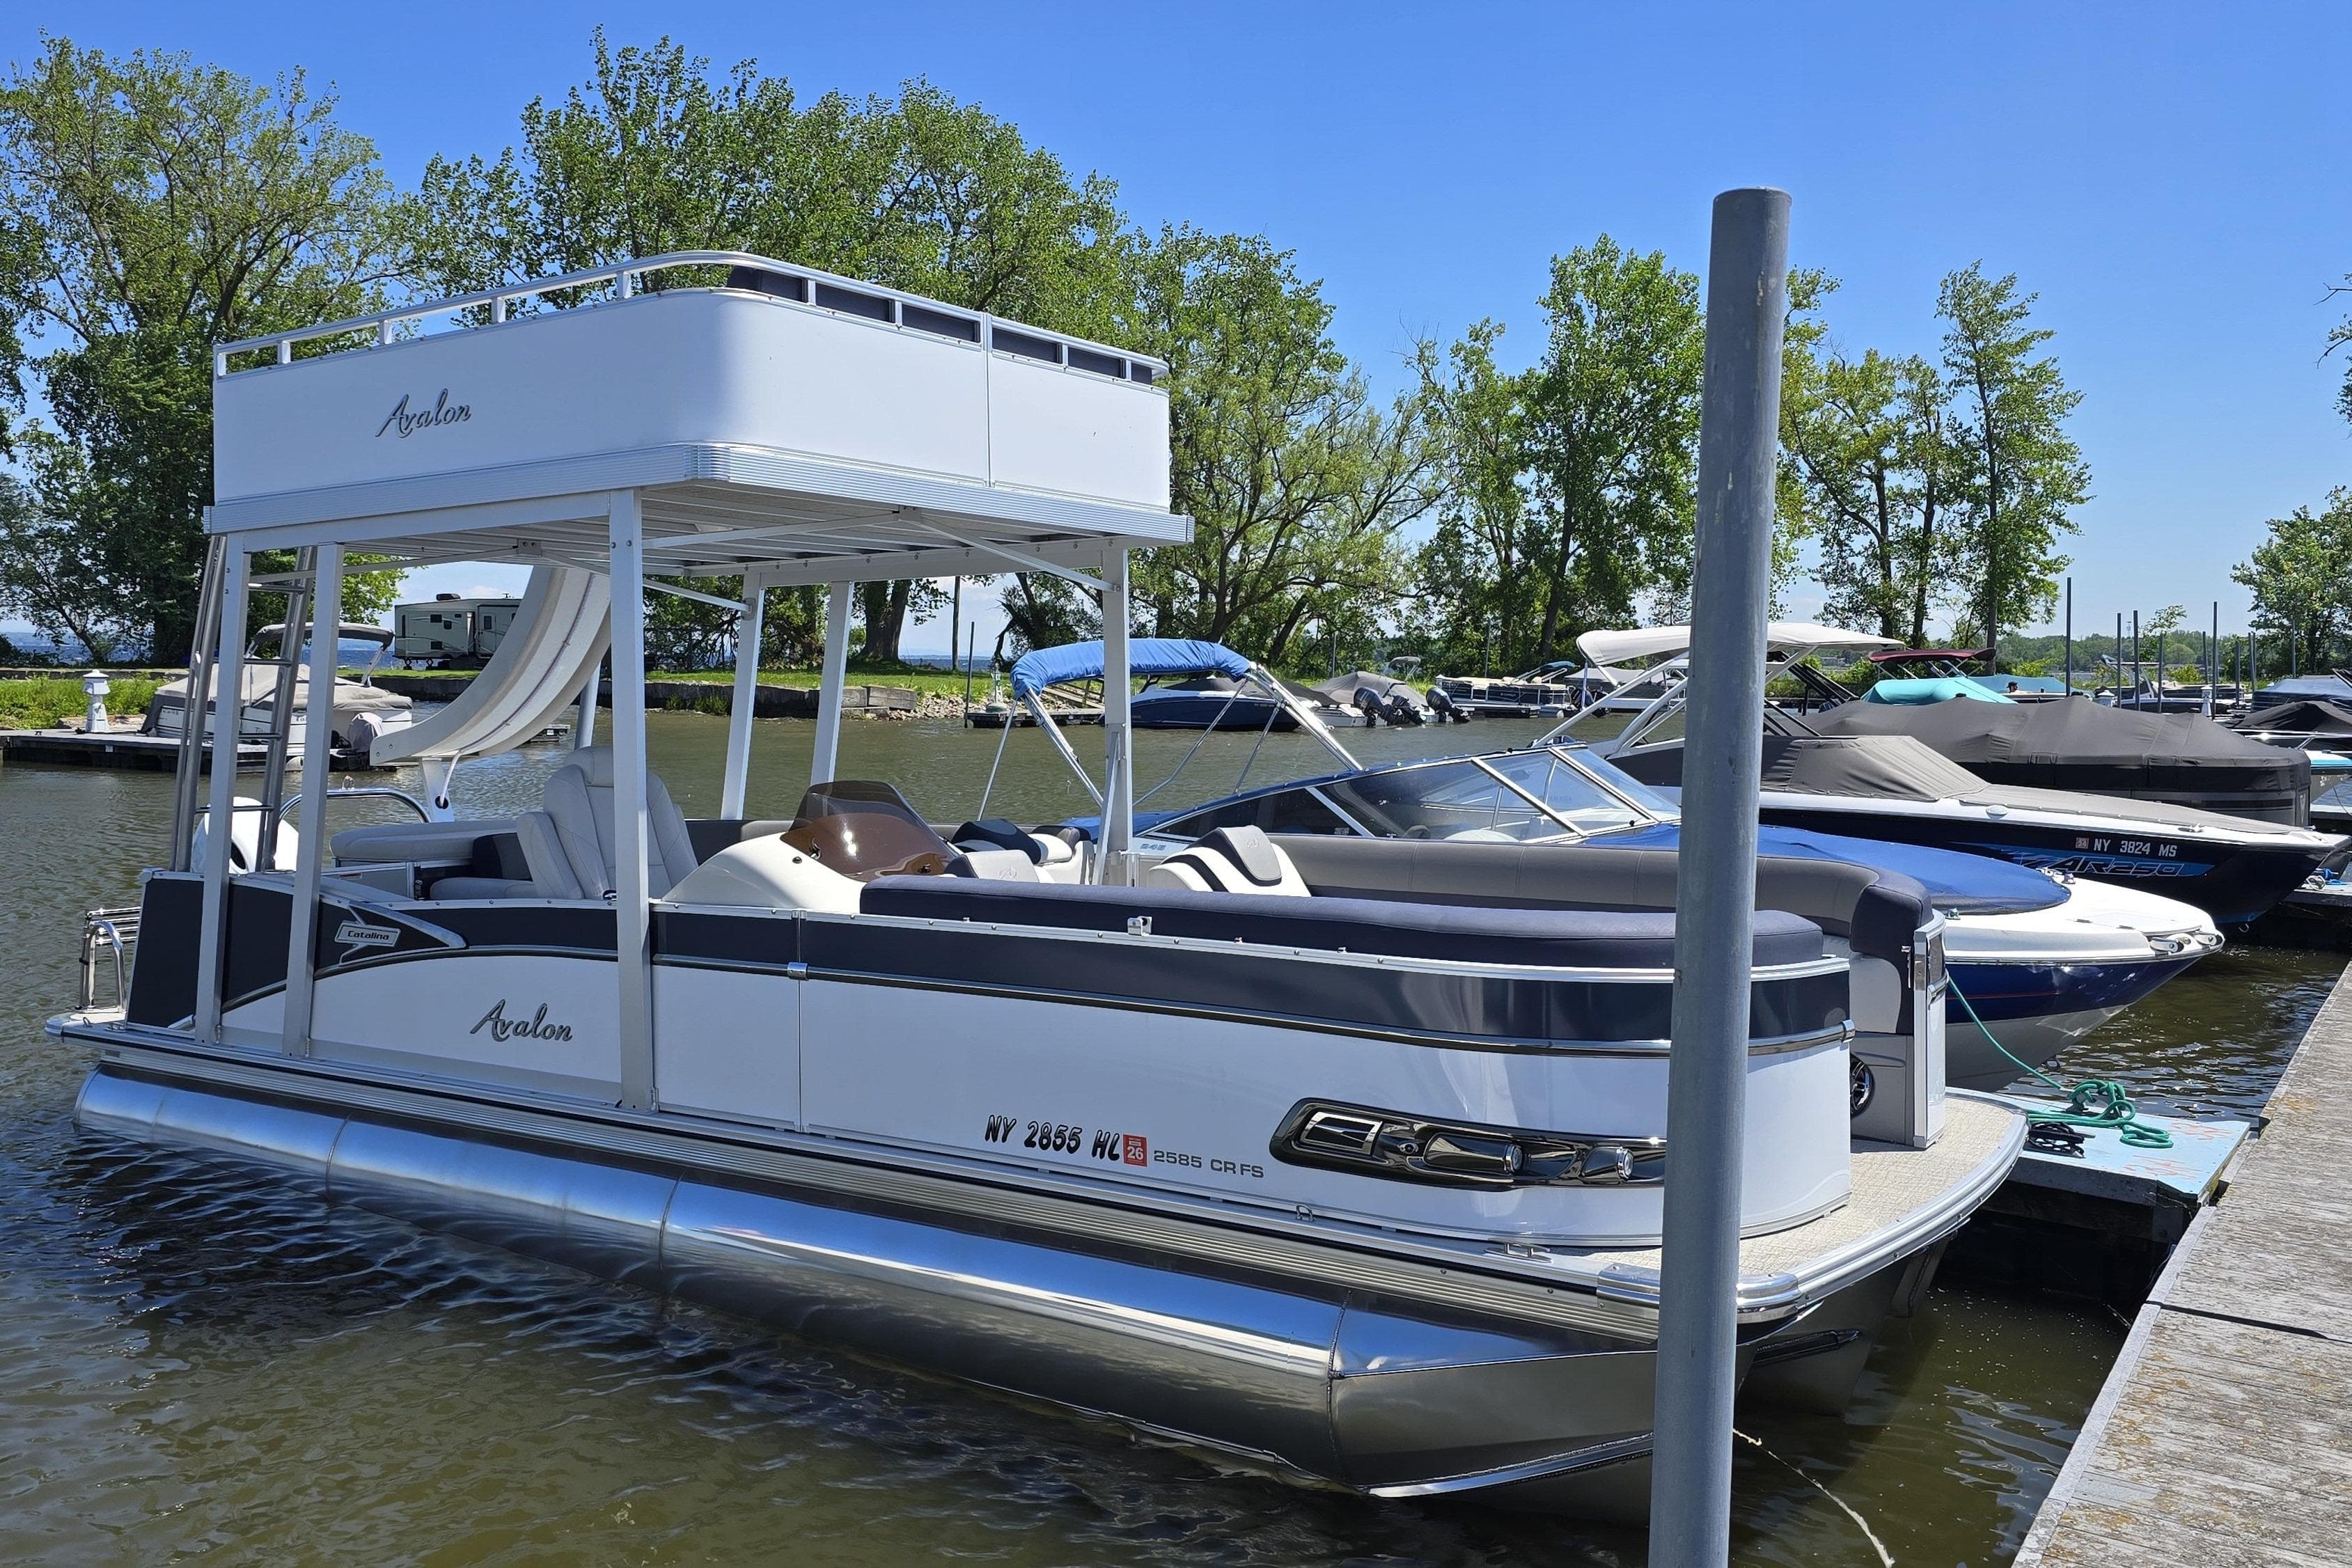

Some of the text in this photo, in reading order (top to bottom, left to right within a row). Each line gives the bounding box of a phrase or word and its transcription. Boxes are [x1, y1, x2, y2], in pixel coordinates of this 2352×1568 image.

[375, 388, 472, 439] Avalon
[2093, 838, 2111, 852] NY
[2119, 840, 2151, 855] 3824
[2158, 844, 2178, 857] MS
[348, 930, 390, 940] Catalina
[469, 998, 573, 1042] Avalon
[985, 1114, 1120, 1161] NY 2855 HL
[1127, 1146, 1144, 1161] 26
[1154, 1150, 1202, 1168] 2585
